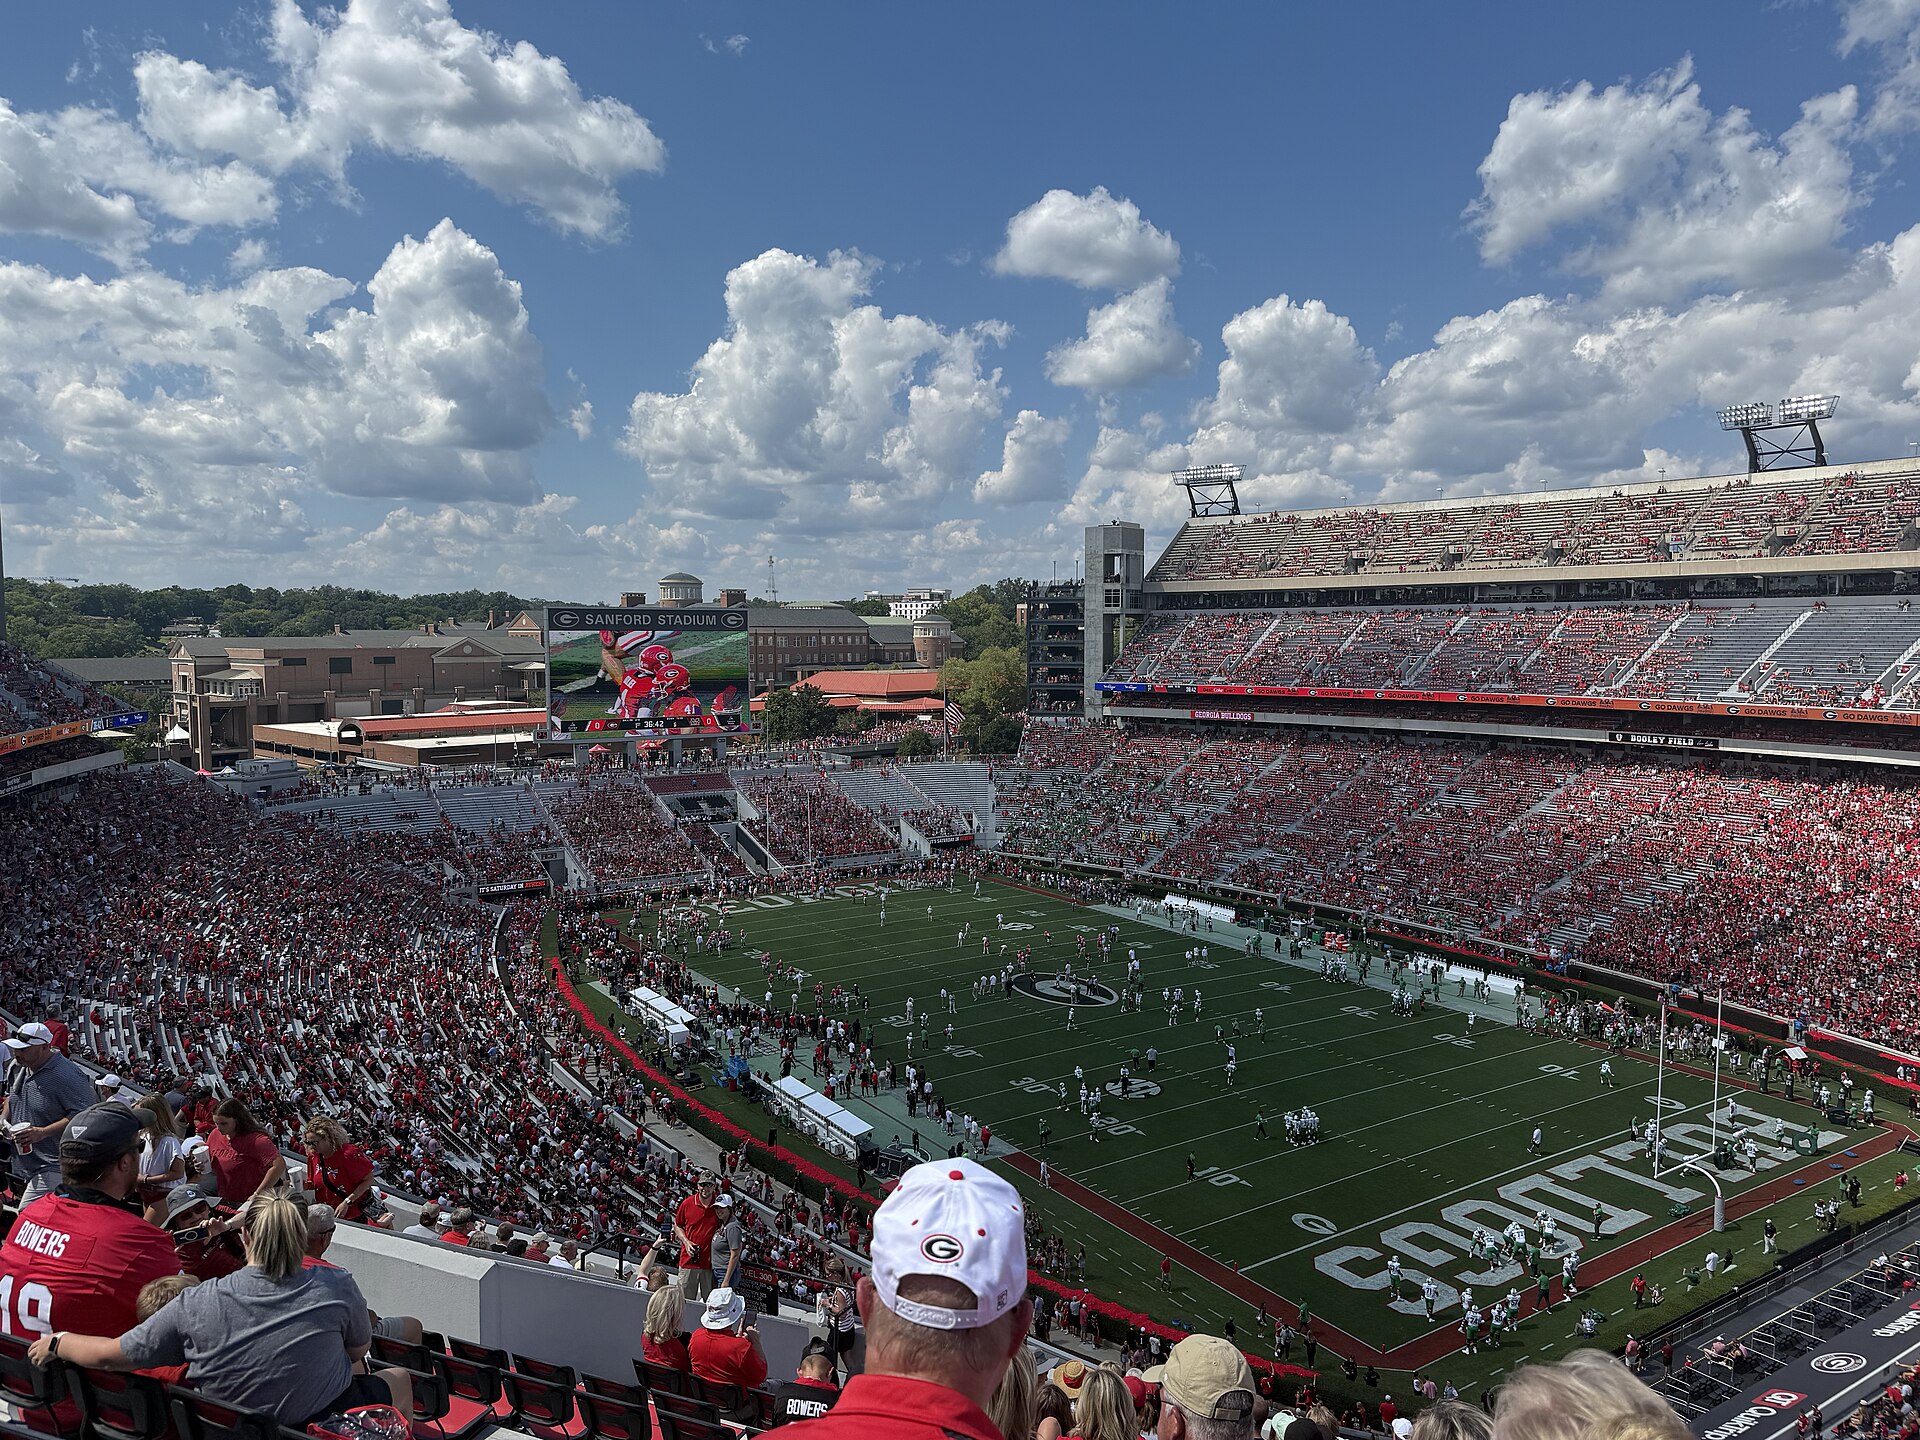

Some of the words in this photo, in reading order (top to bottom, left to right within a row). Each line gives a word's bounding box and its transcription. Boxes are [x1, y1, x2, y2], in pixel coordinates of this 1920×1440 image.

[585, 614, 652, 626] SANFORD
[658, 615, 716, 626] STADIUM
[684, 704, 696, 714] 41
[1194, 711, 1220, 719] GEORGIA
[1220, 712, 1252, 720] BULLDOGS
[1856, 714, 1889, 722] DAWGS
[1630, 734, 1666, 744] DOOLEY
[1668, 737, 1694, 746] FIELD
[490, 883, 517, 892] SATURDAY
[1538, 1064, 1580, 1077] 10
[1009, 1077, 1050, 1093] 30
[1193, 1166, 1241, 1187] 10
[14, 1220, 70, 1258] BOWERS
[920, 1234, 964, 1263] G
[740, 1268, 758, 1278] EVEL
[760, 1272, 772, 1282] 300
[0, 1274, 53, 1341] 19
[1764, 1392, 1799, 1407] QT
[1703, 1406, 1777, 1440] QuikTrip
